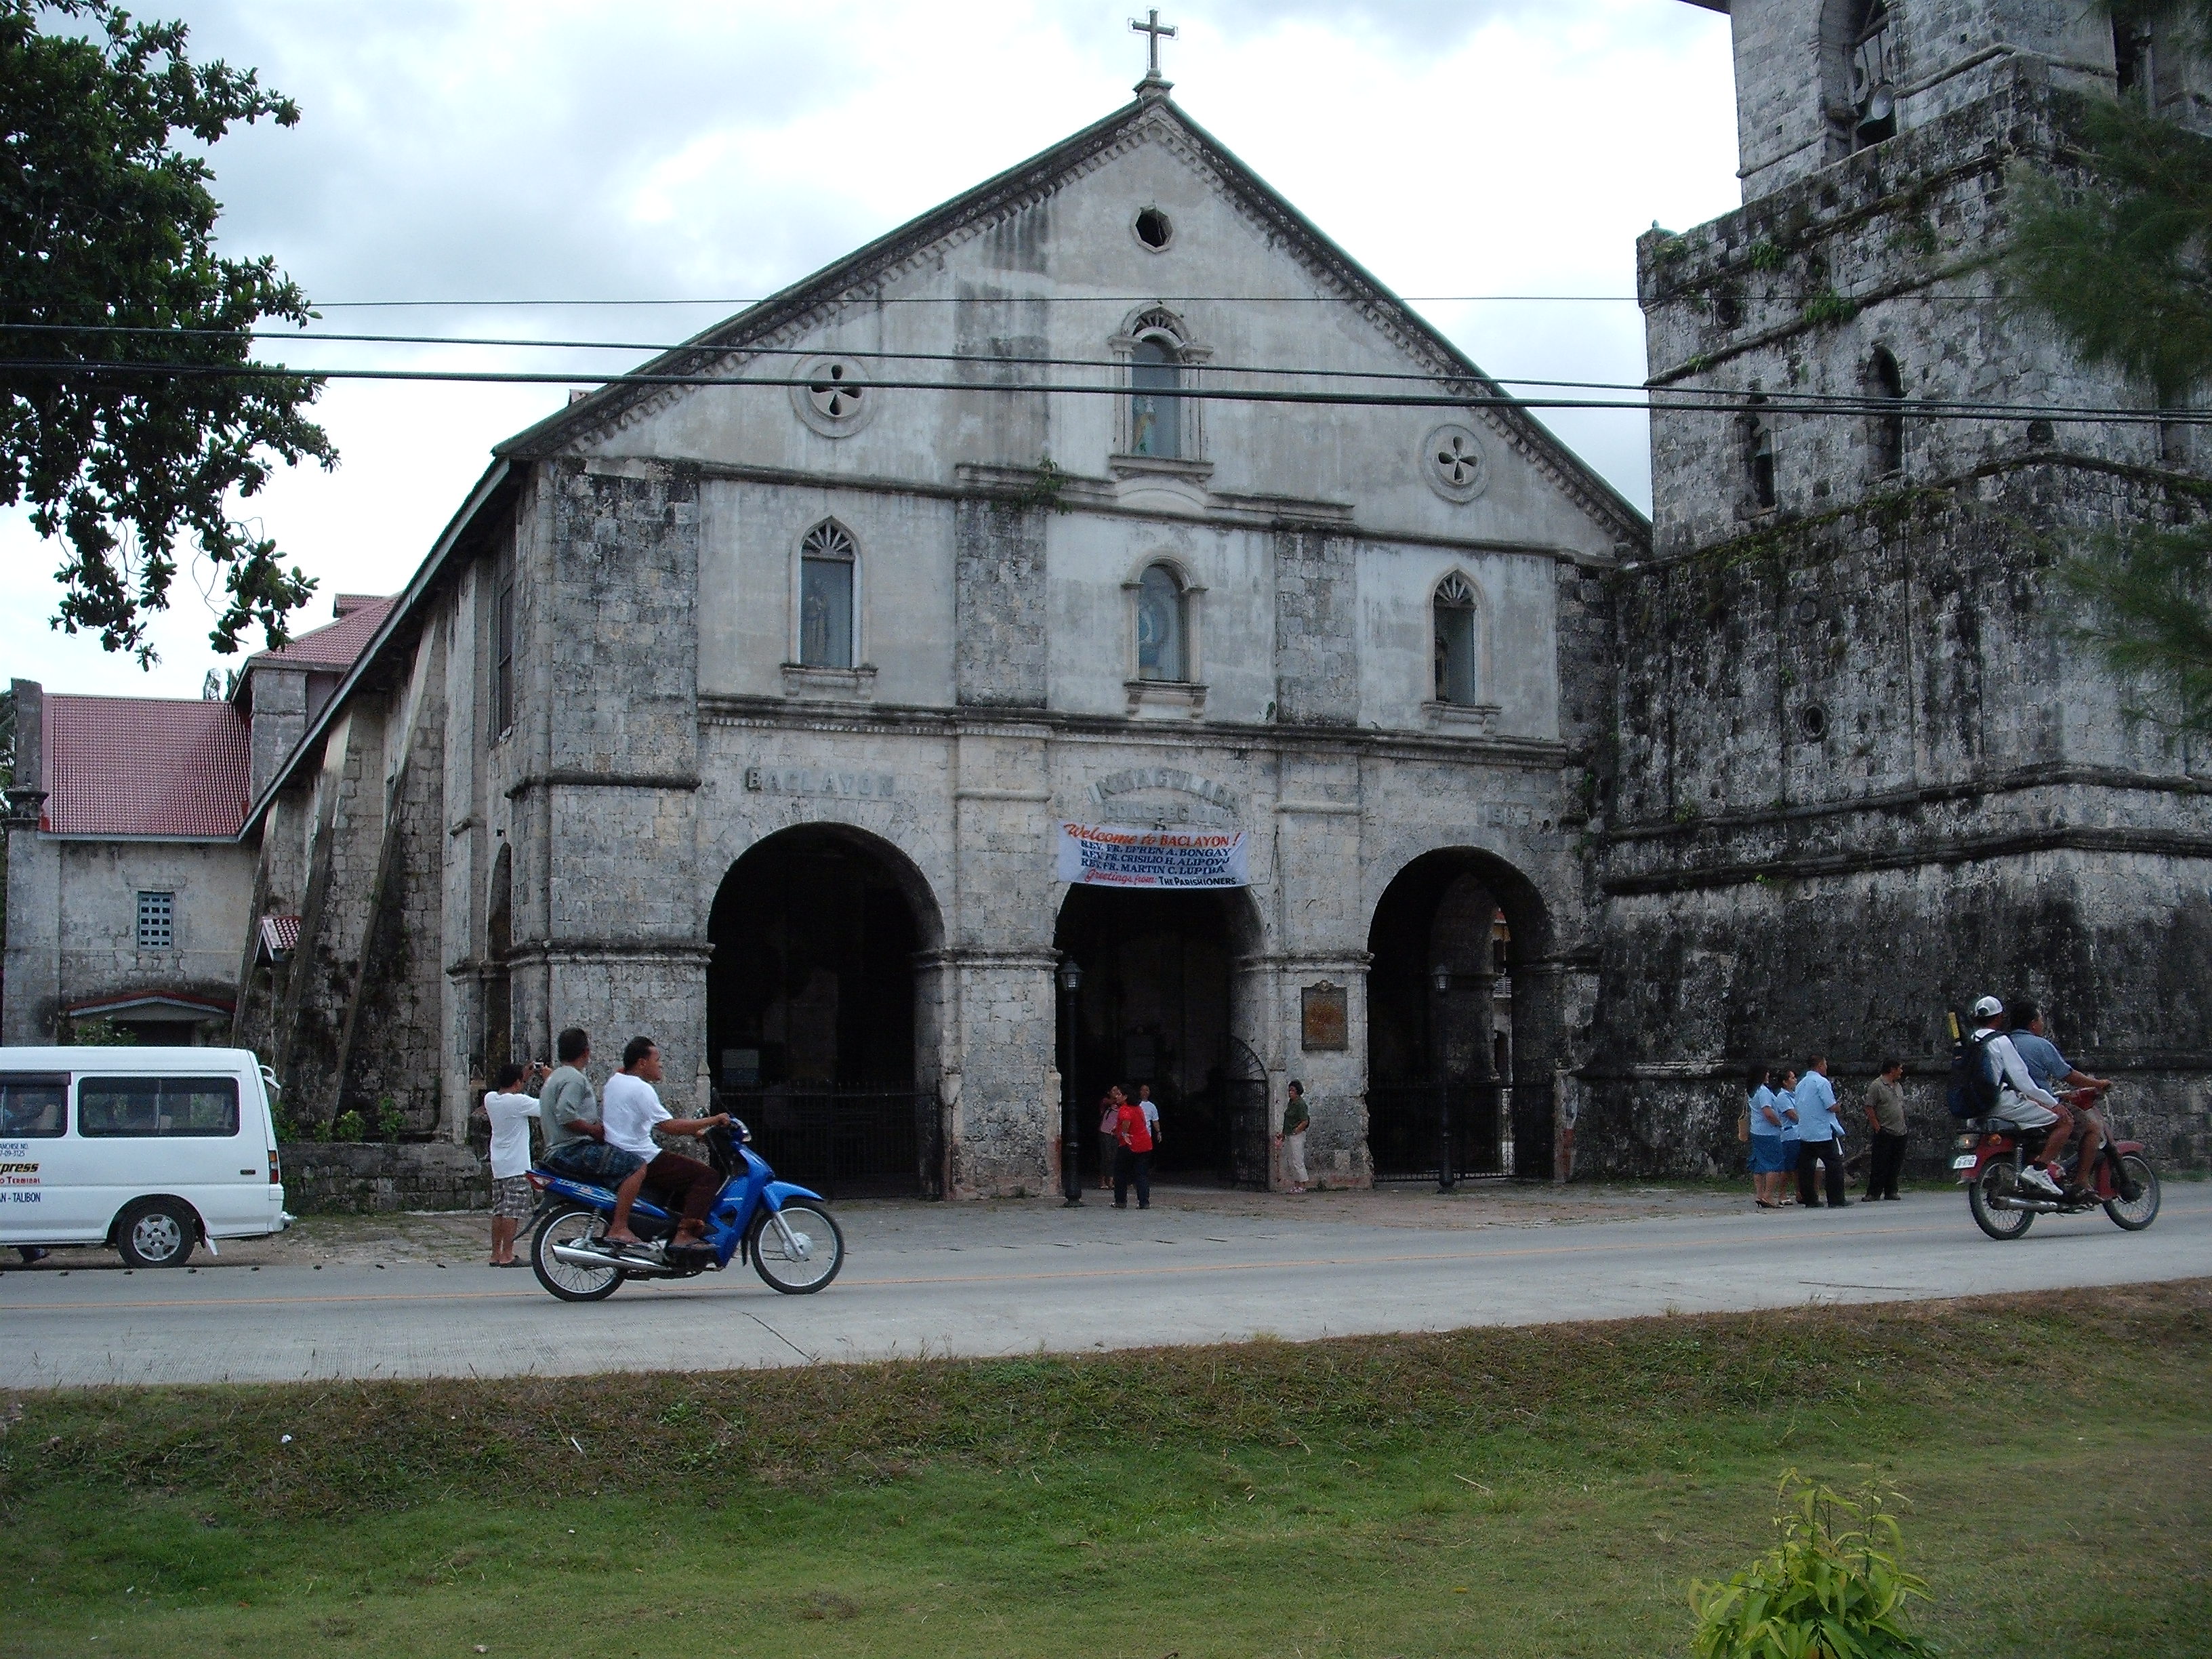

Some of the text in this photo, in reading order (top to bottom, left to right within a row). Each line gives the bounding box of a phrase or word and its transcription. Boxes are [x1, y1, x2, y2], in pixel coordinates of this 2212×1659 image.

[745, 766, 895, 796] BACLAYON
[1063, 823, 1138, 844] Welcome
[1141, 833, 1156, 845] to
[1160, 834, 1229, 847] BACLAYON
[1081, 840, 1103, 851] REV.
[1107, 844, 1122, 853] FR.
[1166, 848, 1178, 856] A.
[1179, 848, 1231, 857] BONGAY
[1121, 855, 1163, 864] CRISILIO
[1084, 868, 1131, 884] Greetings
[1121, 863, 1165, 874] MARTIN
[1168, 866, 1177, 875] C.
[0, 1163, 39, 1175] press
[13, 1192, 41, 1202] TALIBON
